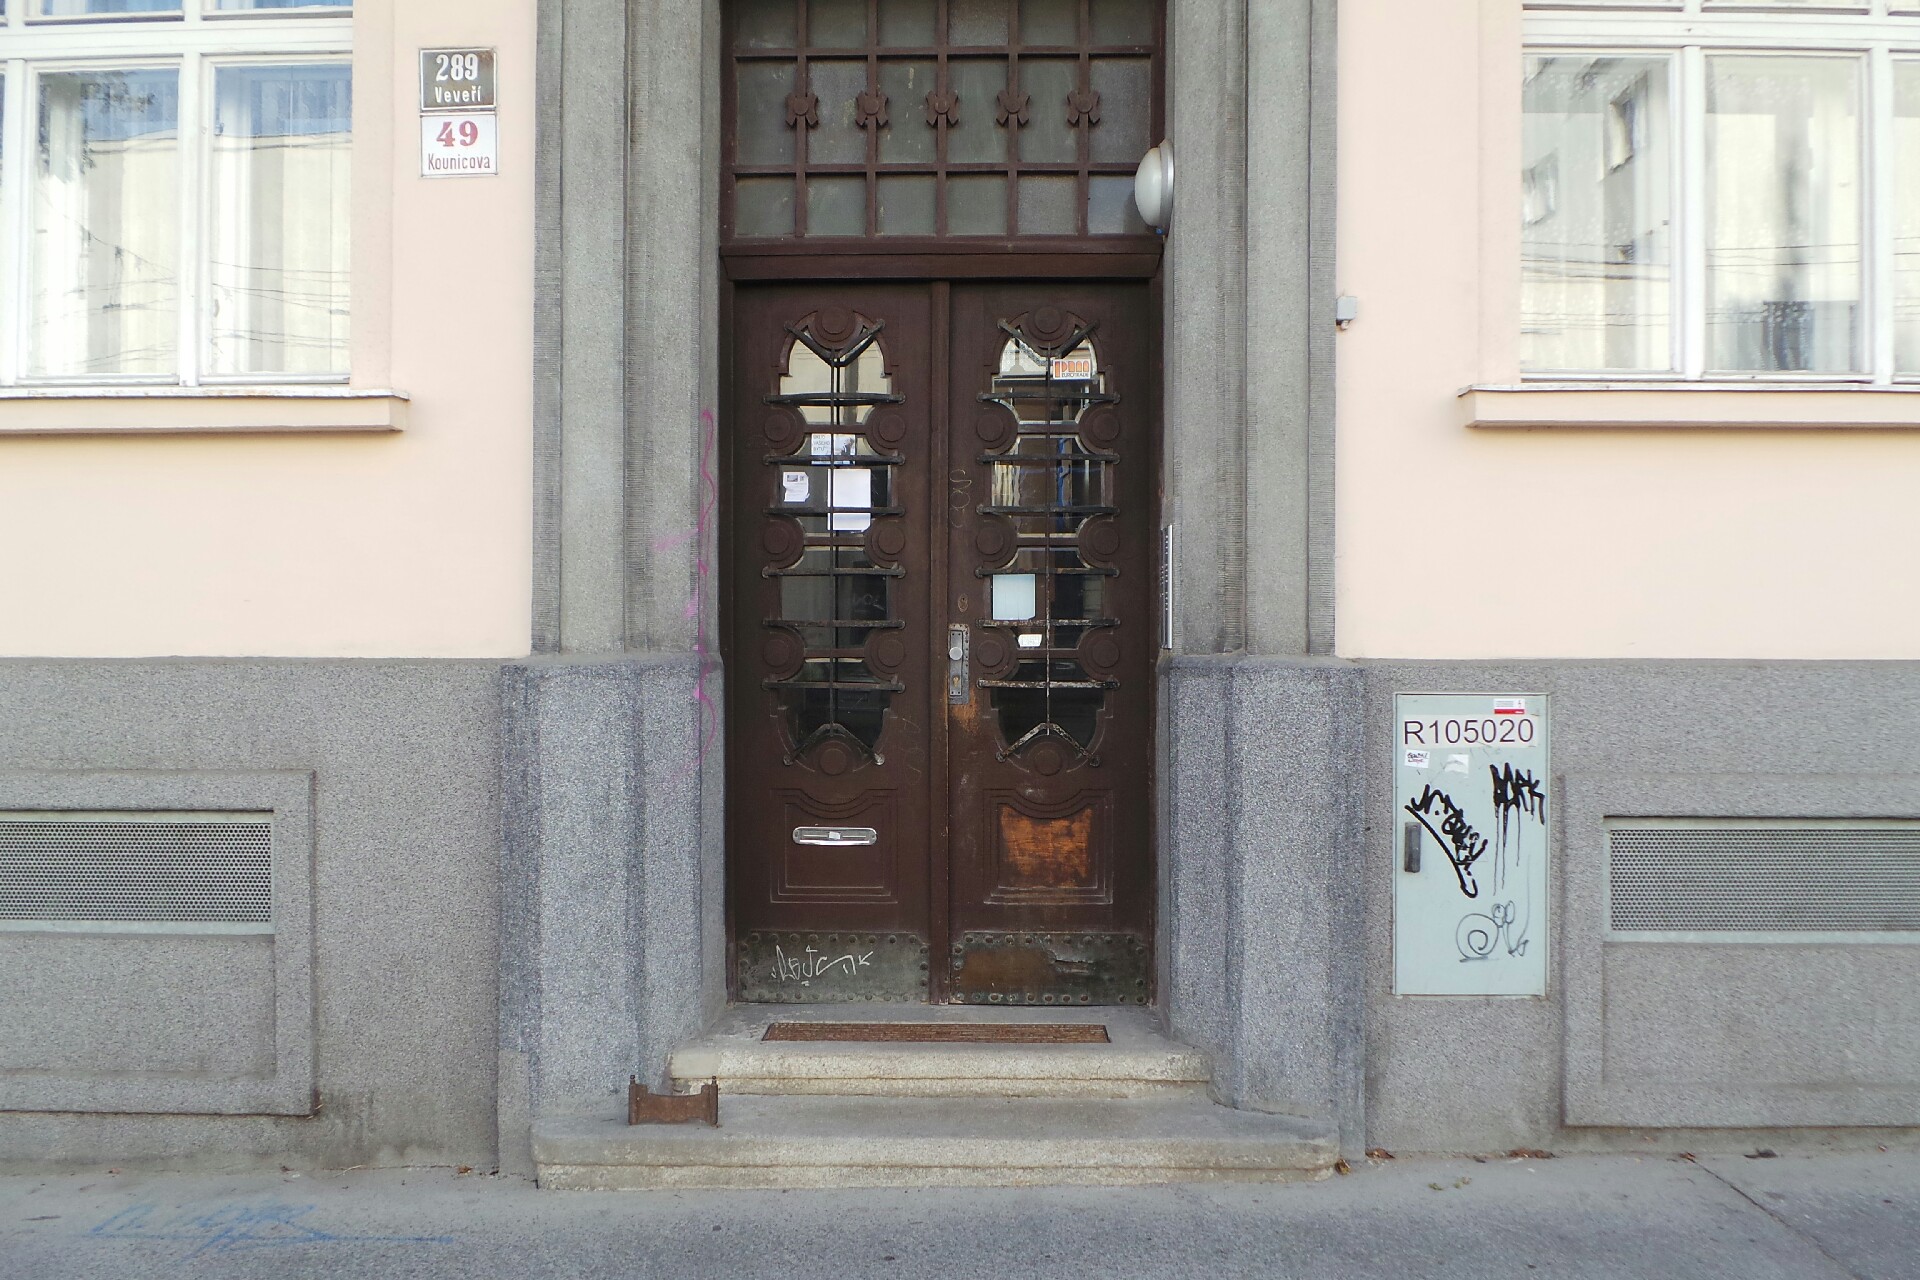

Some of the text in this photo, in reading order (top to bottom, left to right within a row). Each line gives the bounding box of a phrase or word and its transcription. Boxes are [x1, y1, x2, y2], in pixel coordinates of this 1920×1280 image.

[435, 53, 479, 81] 289
[434, 85, 482, 103] Veveří
[436, 120, 479, 147] 49
[428, 153, 491, 171] Kounicova
[1404, 718, 1534, 745] R105020
